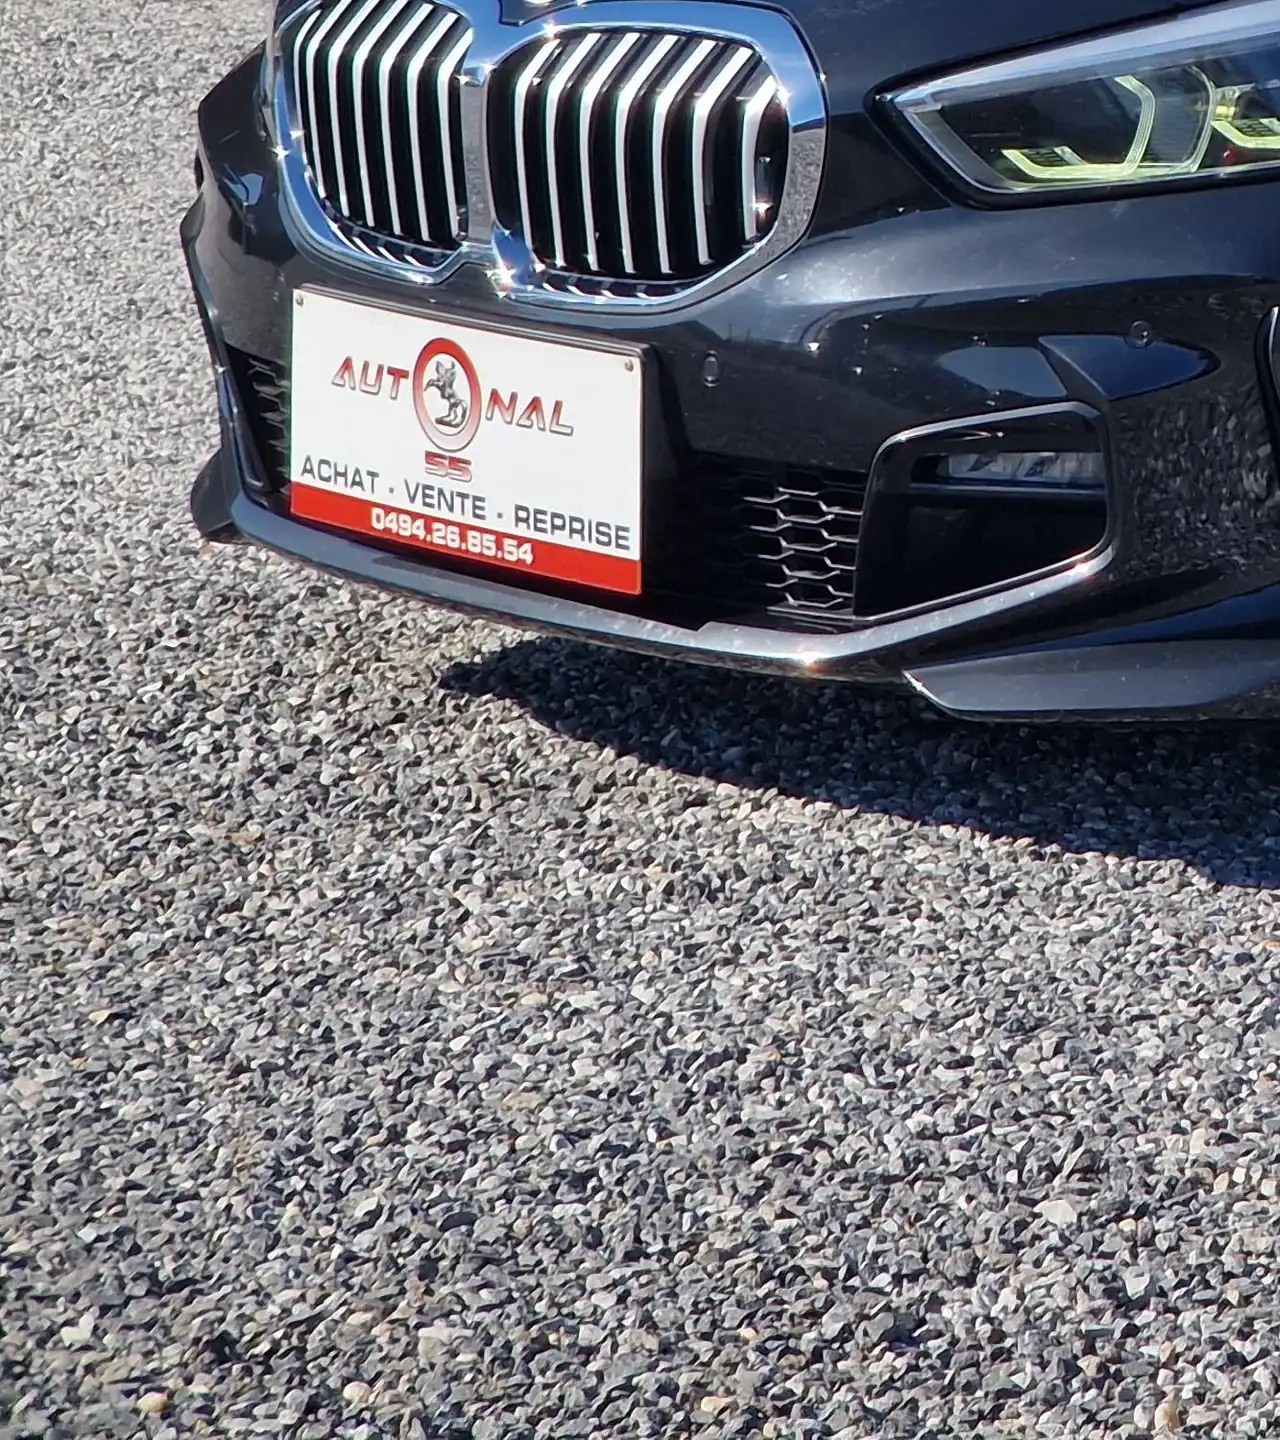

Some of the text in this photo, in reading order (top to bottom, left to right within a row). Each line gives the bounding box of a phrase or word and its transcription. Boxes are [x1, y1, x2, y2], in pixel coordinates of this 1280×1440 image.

[423, 449, 473, 483] 55
[300, 453, 380, 495] ACHAT
[404, 478, 488, 521] VENTE
[513, 503, 632, 552] REPRISE
[370, 506, 534, 566] 0494.26.85.54
